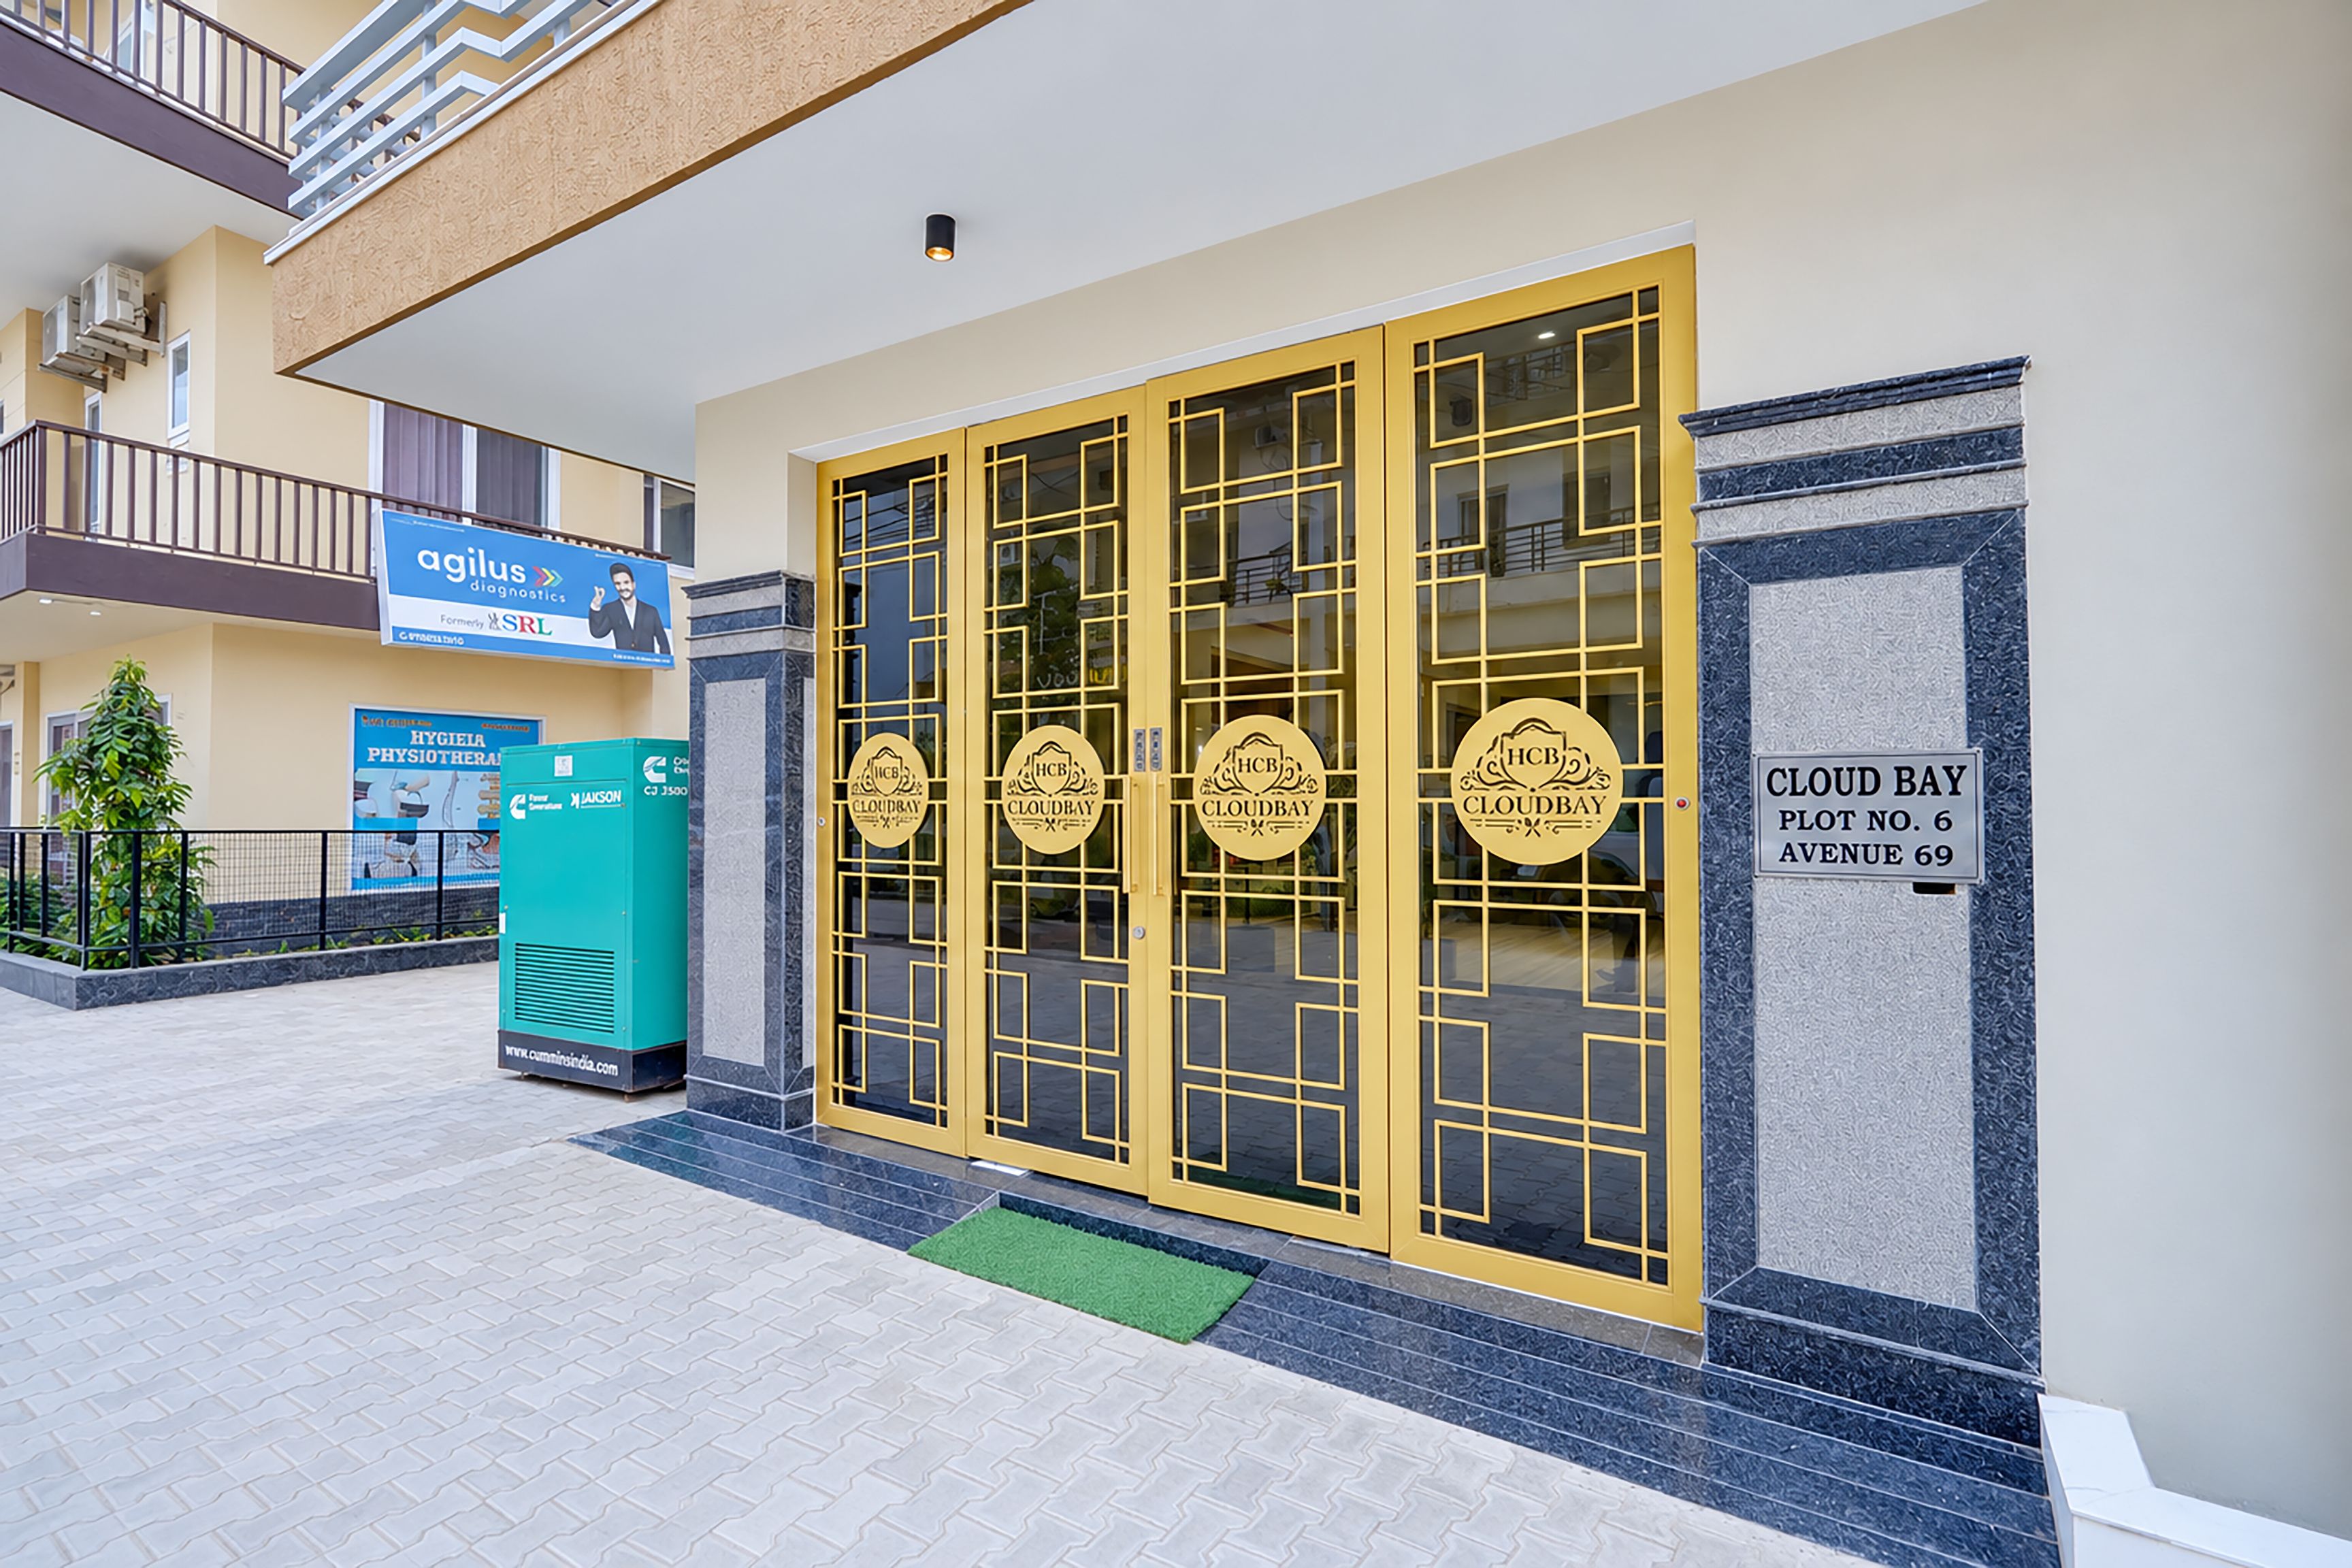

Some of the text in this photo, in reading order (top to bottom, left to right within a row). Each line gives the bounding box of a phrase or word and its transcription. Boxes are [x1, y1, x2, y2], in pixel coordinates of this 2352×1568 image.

[417, 546, 526, 583] agilus
[470, 579, 566, 603] diagnostics
[440, 613, 553, 636] Formerly SRL
[1238, 757, 1279, 774] HCB
[1507, 747, 1560, 766] HCB
[875, 766, 899, 779] HCB
[1036, 762, 1067, 777] HCB
[1766, 765, 1968, 797] CLOUD BAY
[853, 799, 921, 814] CLOUDBAY
[1008, 800, 1095, 815] CLOUDBAY
[1202, 800, 1313, 817] CLOUDBAY
[1463, 795, 1607, 815] CLOUDBAY
[1778, 809, 1953, 832] PLOT NO. 6
[1778, 842, 1954, 867] AVENUE 69
